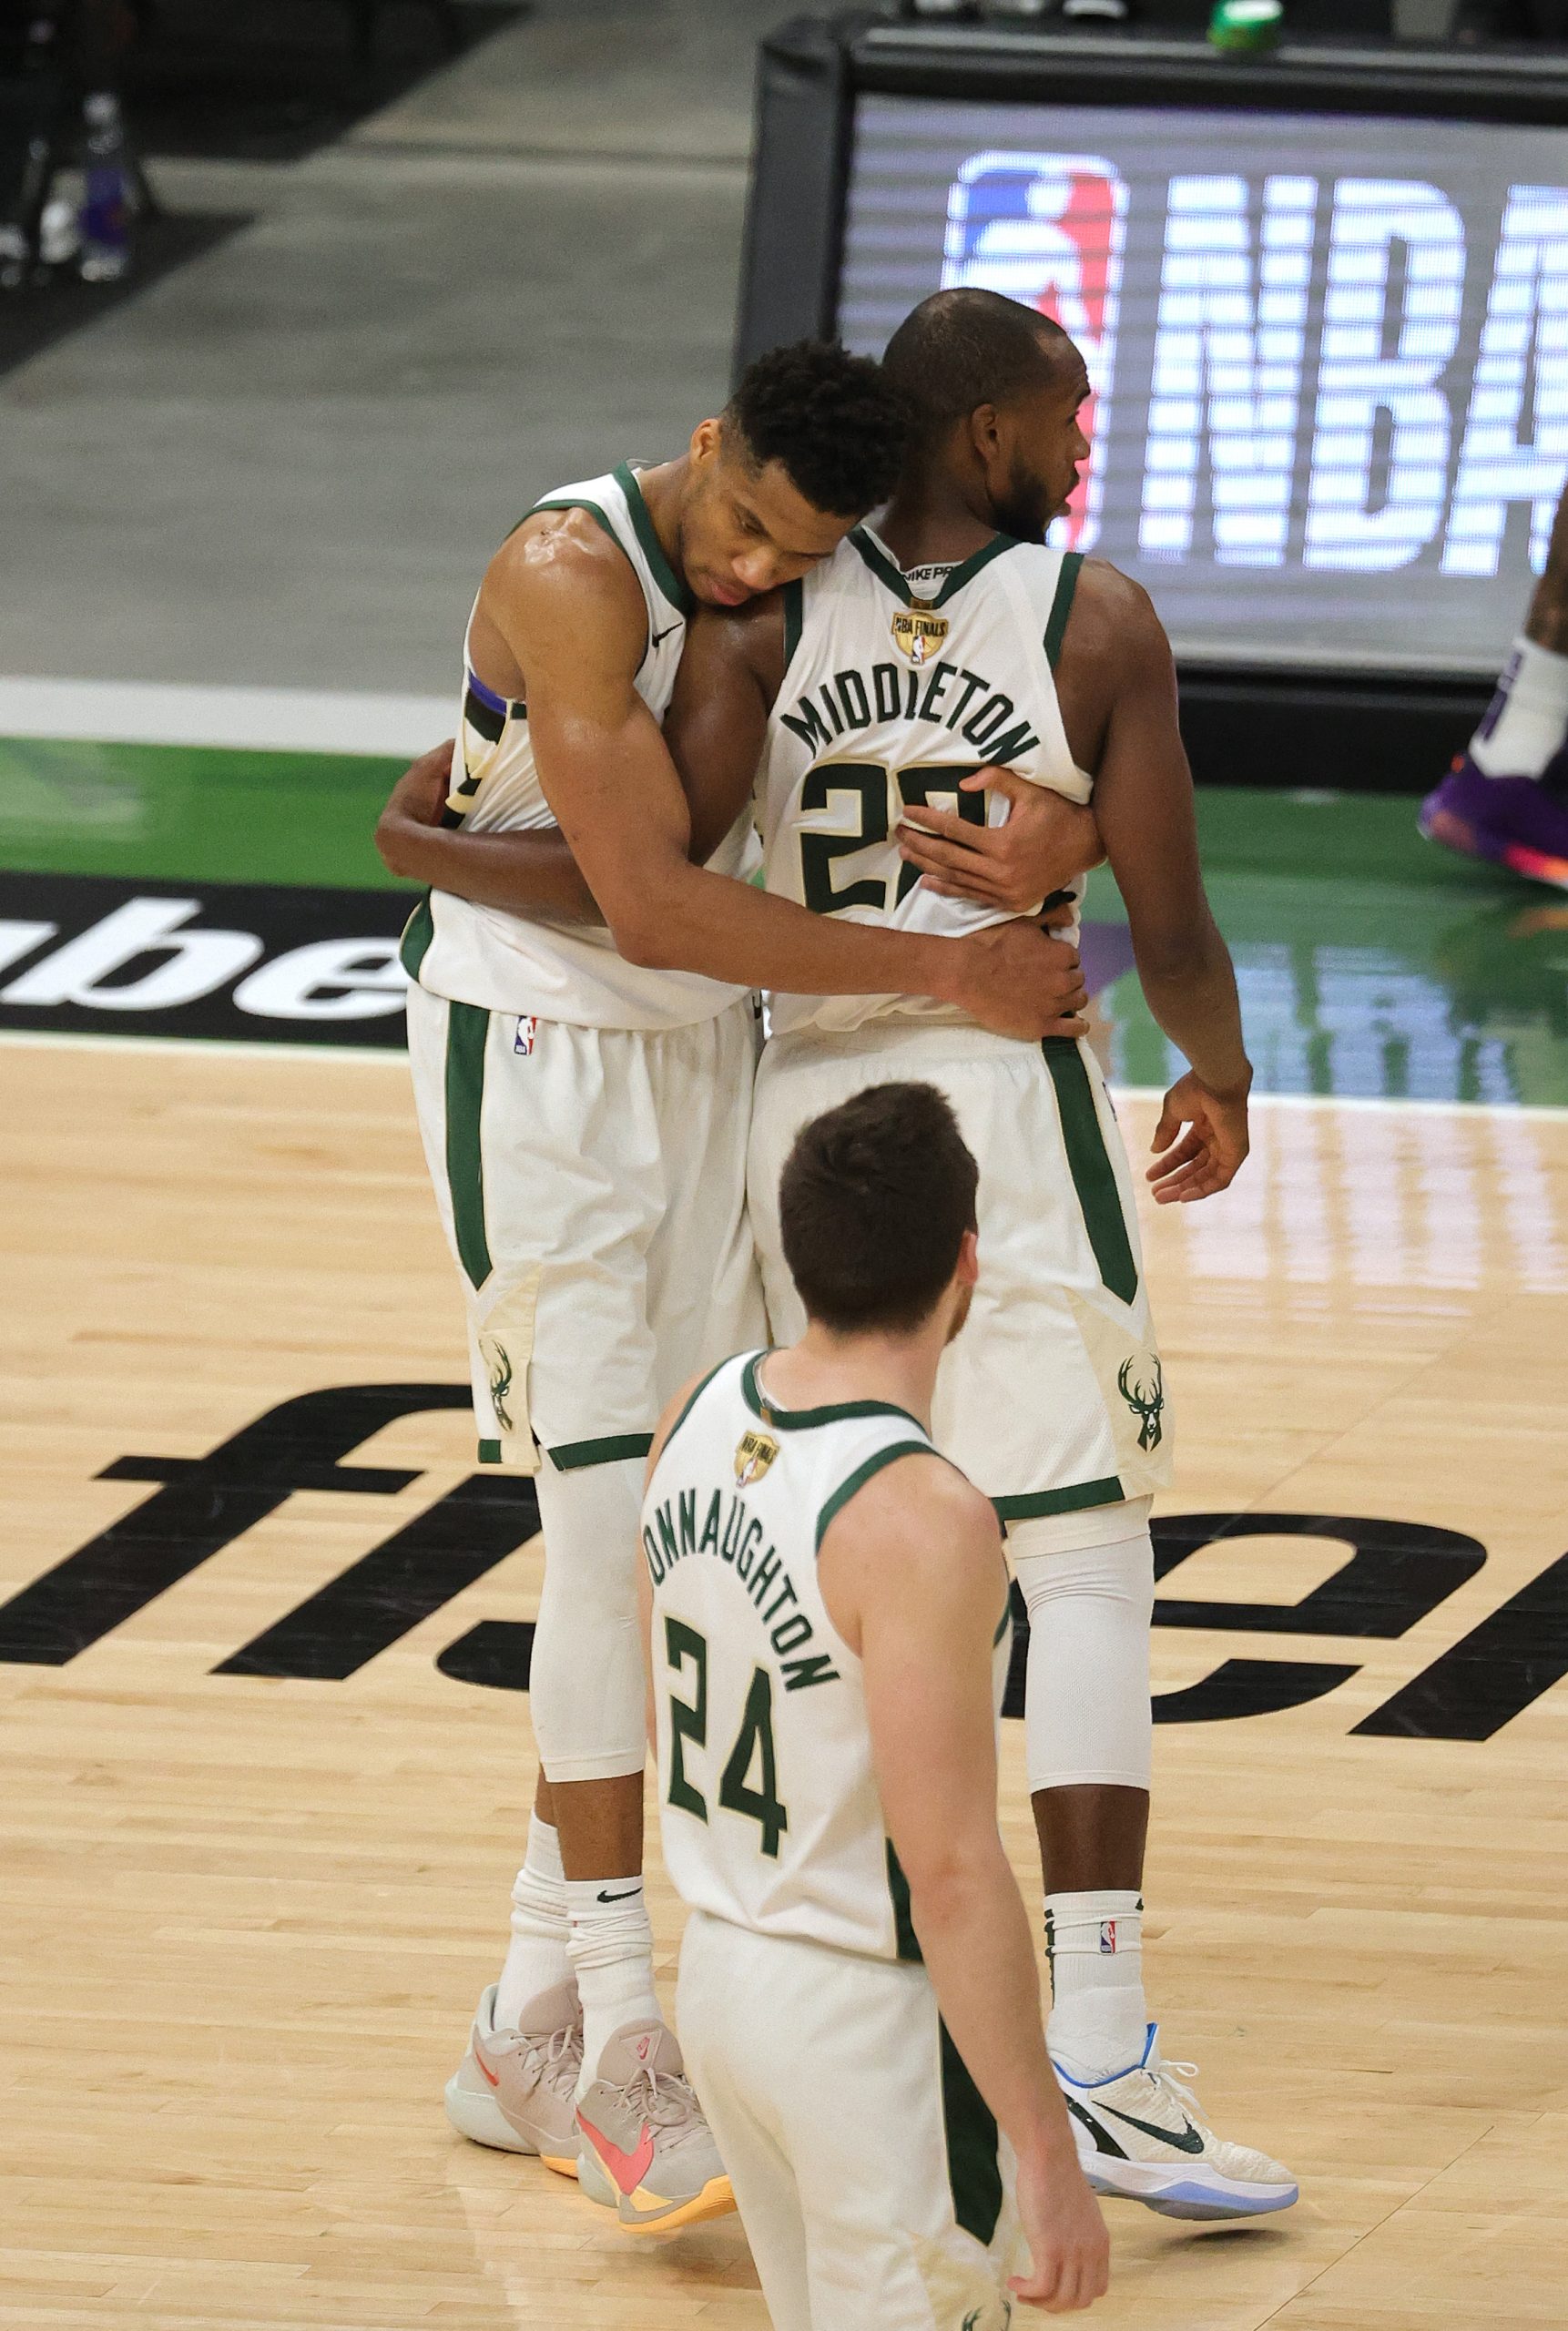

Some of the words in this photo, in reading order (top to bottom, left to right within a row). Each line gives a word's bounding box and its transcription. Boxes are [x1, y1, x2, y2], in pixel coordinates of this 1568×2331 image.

[1137, 174, 1568, 577] NBA
[779, 661, 1041, 767] MIDDLETON
[915, 620, 946, 637] FINALS
[664, 1615, 789, 1860] 24
